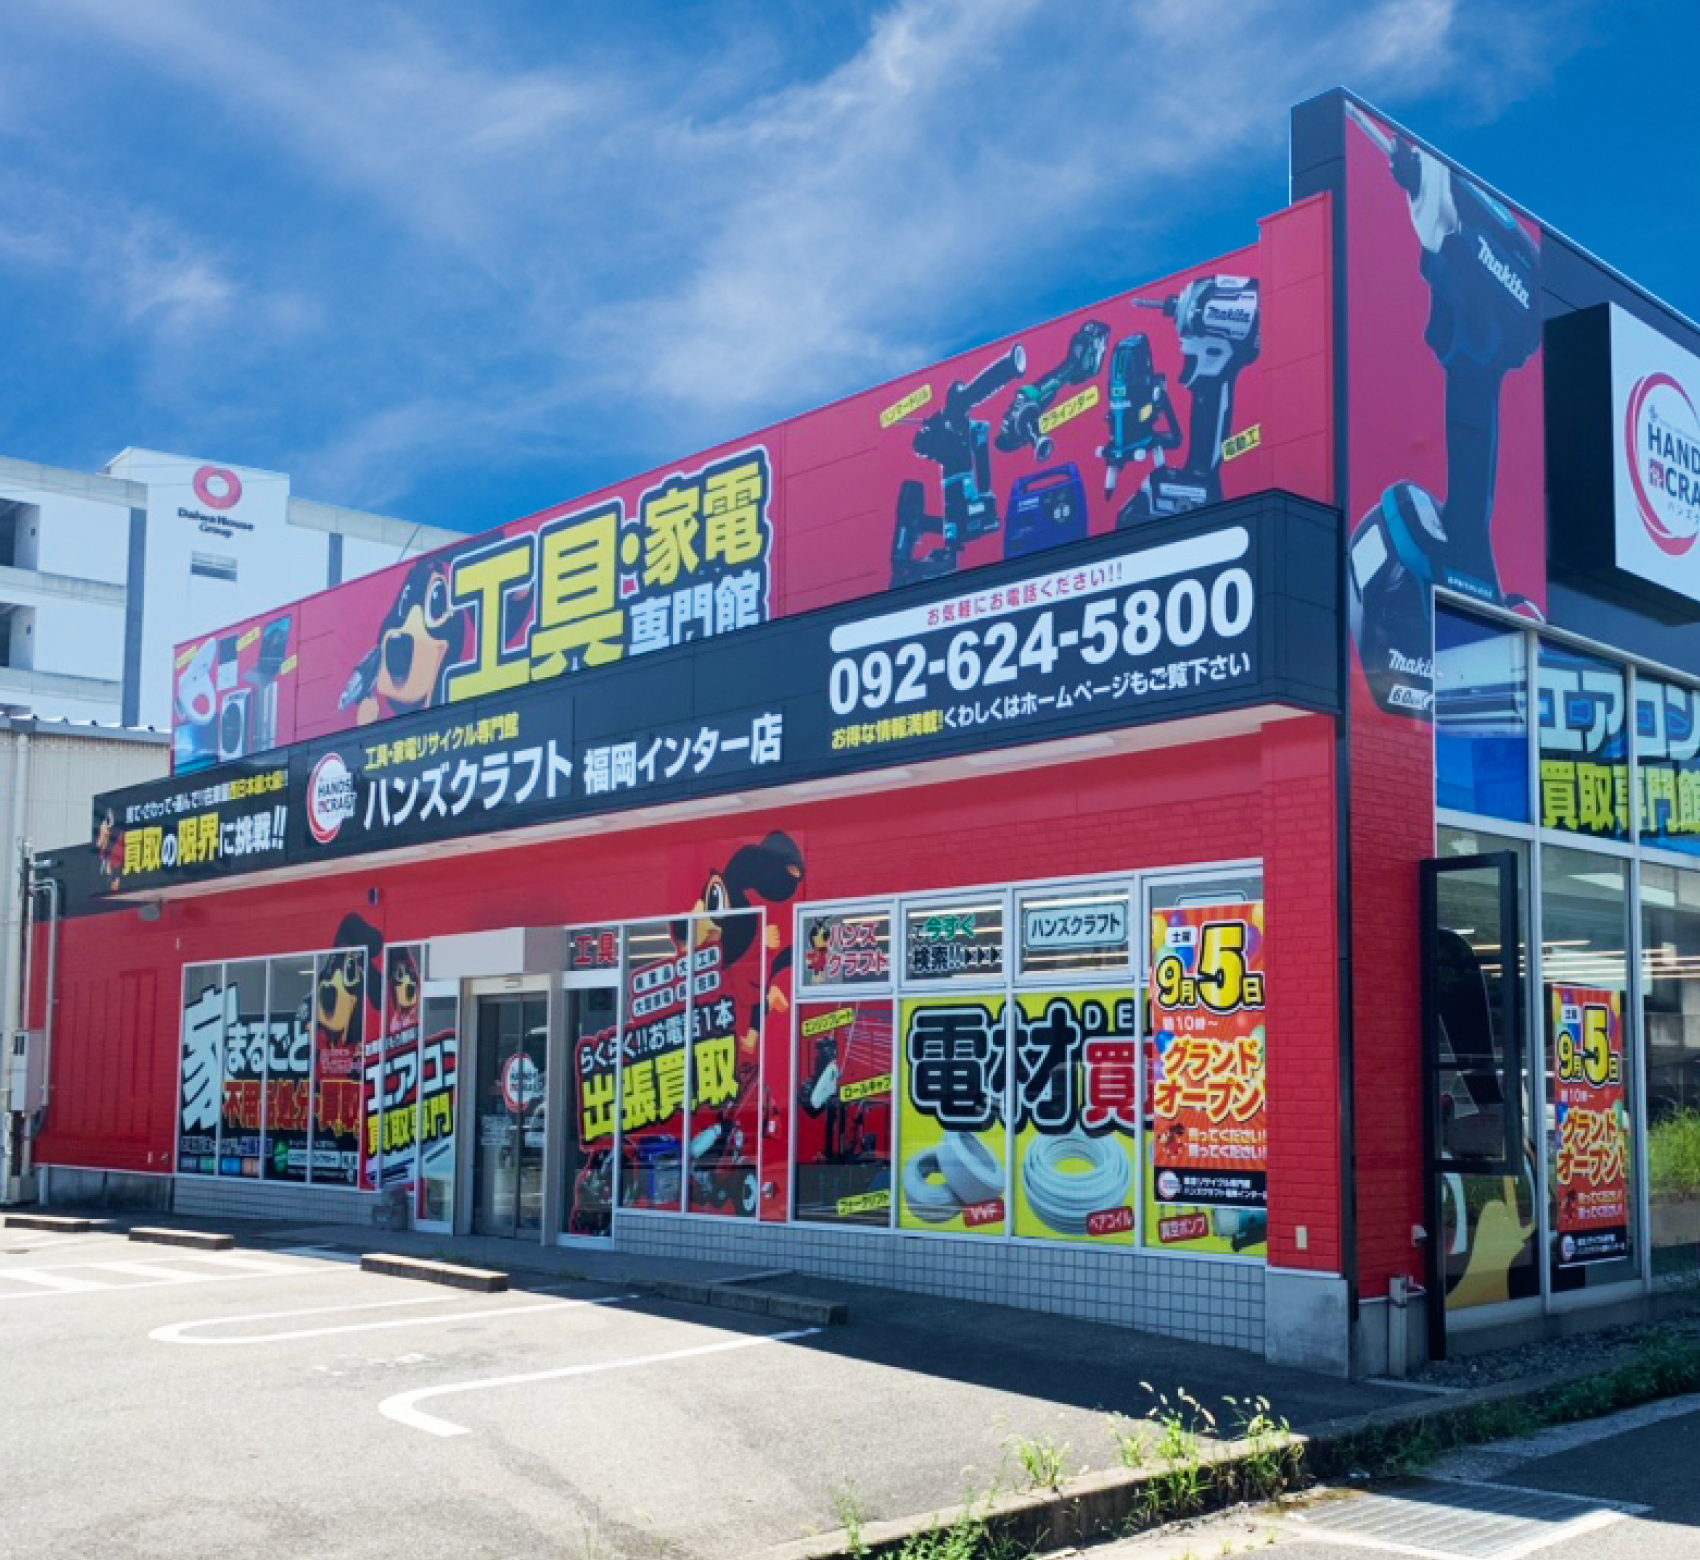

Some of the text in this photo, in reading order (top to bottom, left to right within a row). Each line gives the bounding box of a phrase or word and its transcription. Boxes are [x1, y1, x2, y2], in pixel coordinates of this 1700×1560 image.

[449, 461, 762, 703] 工具・家電
[629, 569, 760, 657] 専門館
[829, 567, 1254, 715] 092-624-5800
[363, 711, 783, 831] ハンズクラフト 福岡インター店
[1031, 911, 1121, 939] ハンズクラフト
[583, 1035, 739, 1142] 出張買取
[1154, 1074, 1267, 1123] オープン
[1162, 1034, 1262, 1081] グランド
